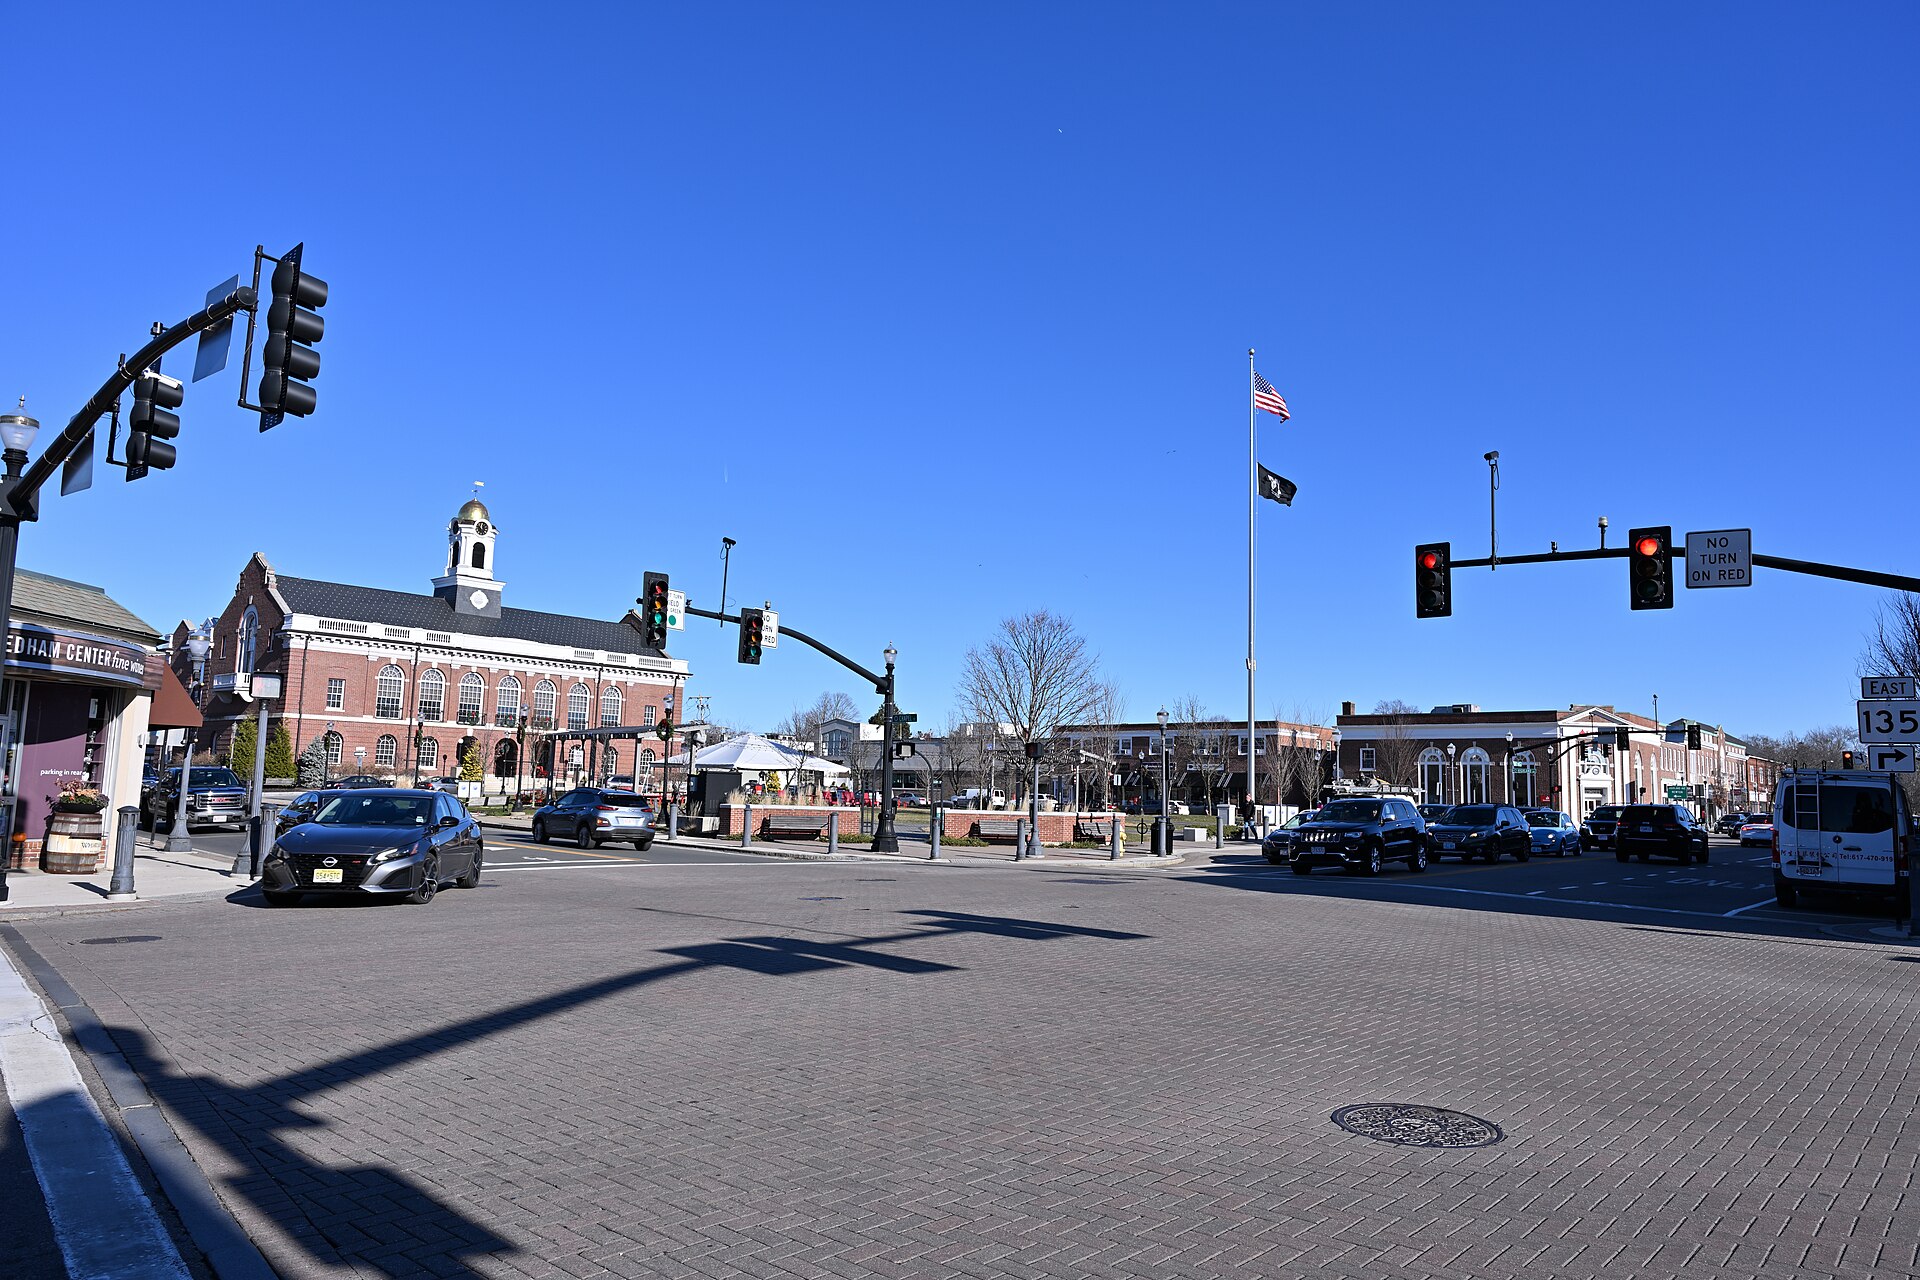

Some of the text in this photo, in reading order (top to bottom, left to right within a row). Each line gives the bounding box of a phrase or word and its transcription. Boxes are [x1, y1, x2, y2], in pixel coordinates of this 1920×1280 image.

[1707, 537, 1728, 549] NO
[1700, 552, 1736, 565] TURN
[1692, 569, 1745, 581] ON RED
[764, 635, 776, 644] RED
[5, 635, 61, 659] EDHAM
[66, 643, 111, 667] CENTER
[111, 651, 130, 671] fine
[1870, 681, 1907, 695] EAST
[898, 714, 912, 722] CHAPEL
[1863, 710, 1919, 734] 135
[40, 768, 63, 777] parking
